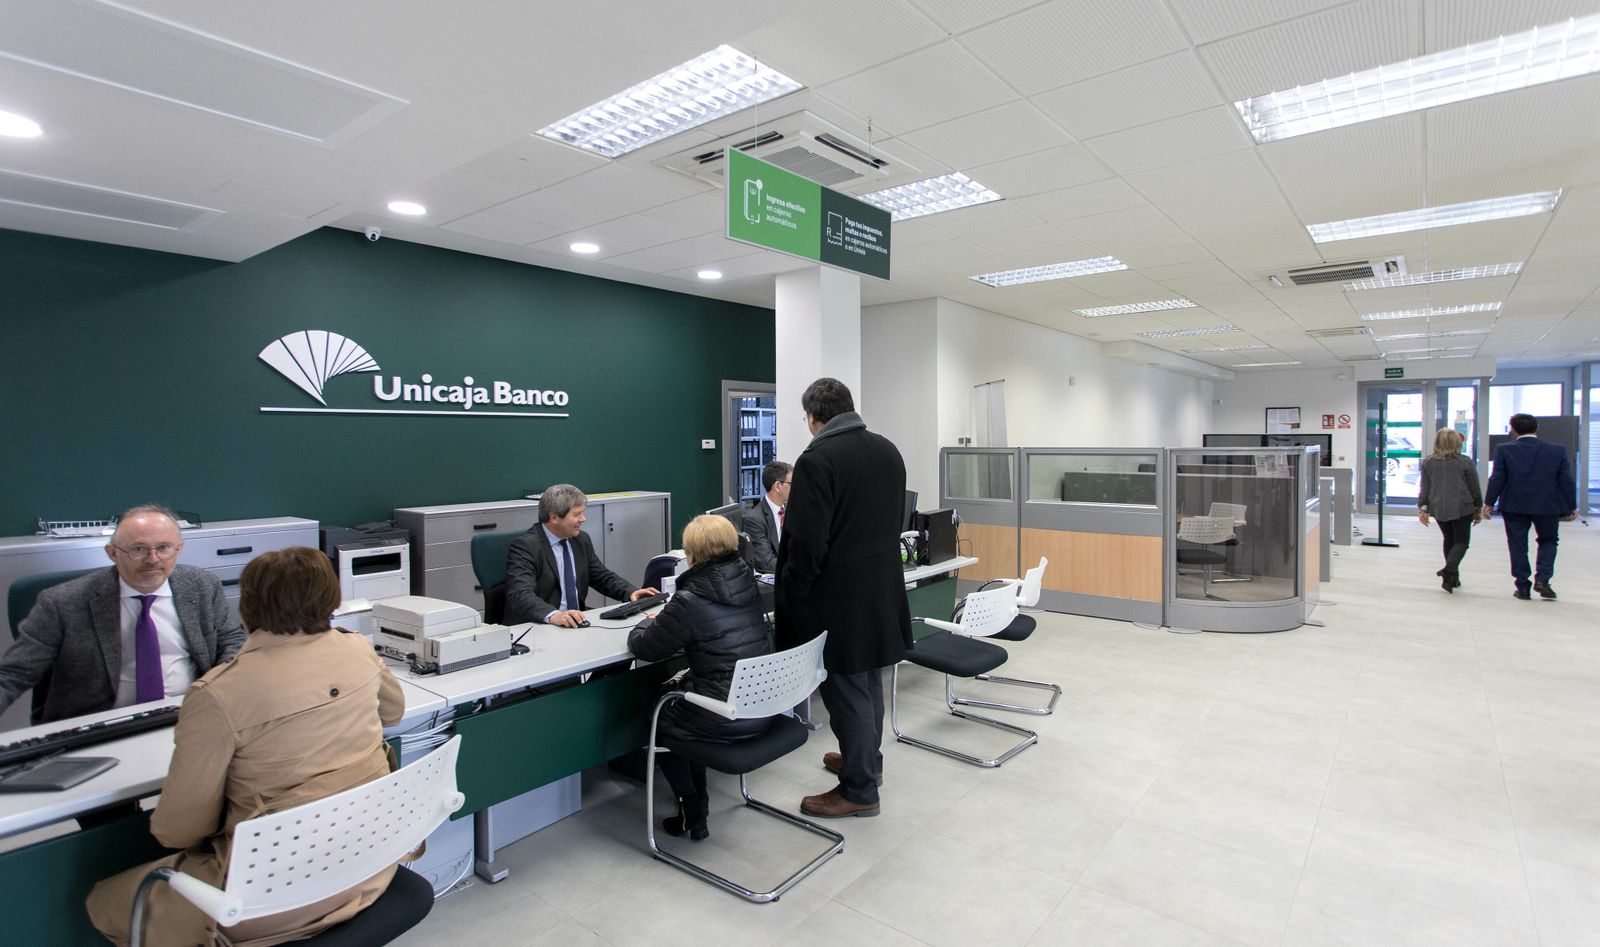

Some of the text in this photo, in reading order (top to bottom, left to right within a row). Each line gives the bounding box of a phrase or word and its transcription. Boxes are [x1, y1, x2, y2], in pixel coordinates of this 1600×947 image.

[773, 206, 792, 218] cajeros
[850, 237, 864, 247] cajeros
[374, 373, 569, 410] Unicaja Banco
